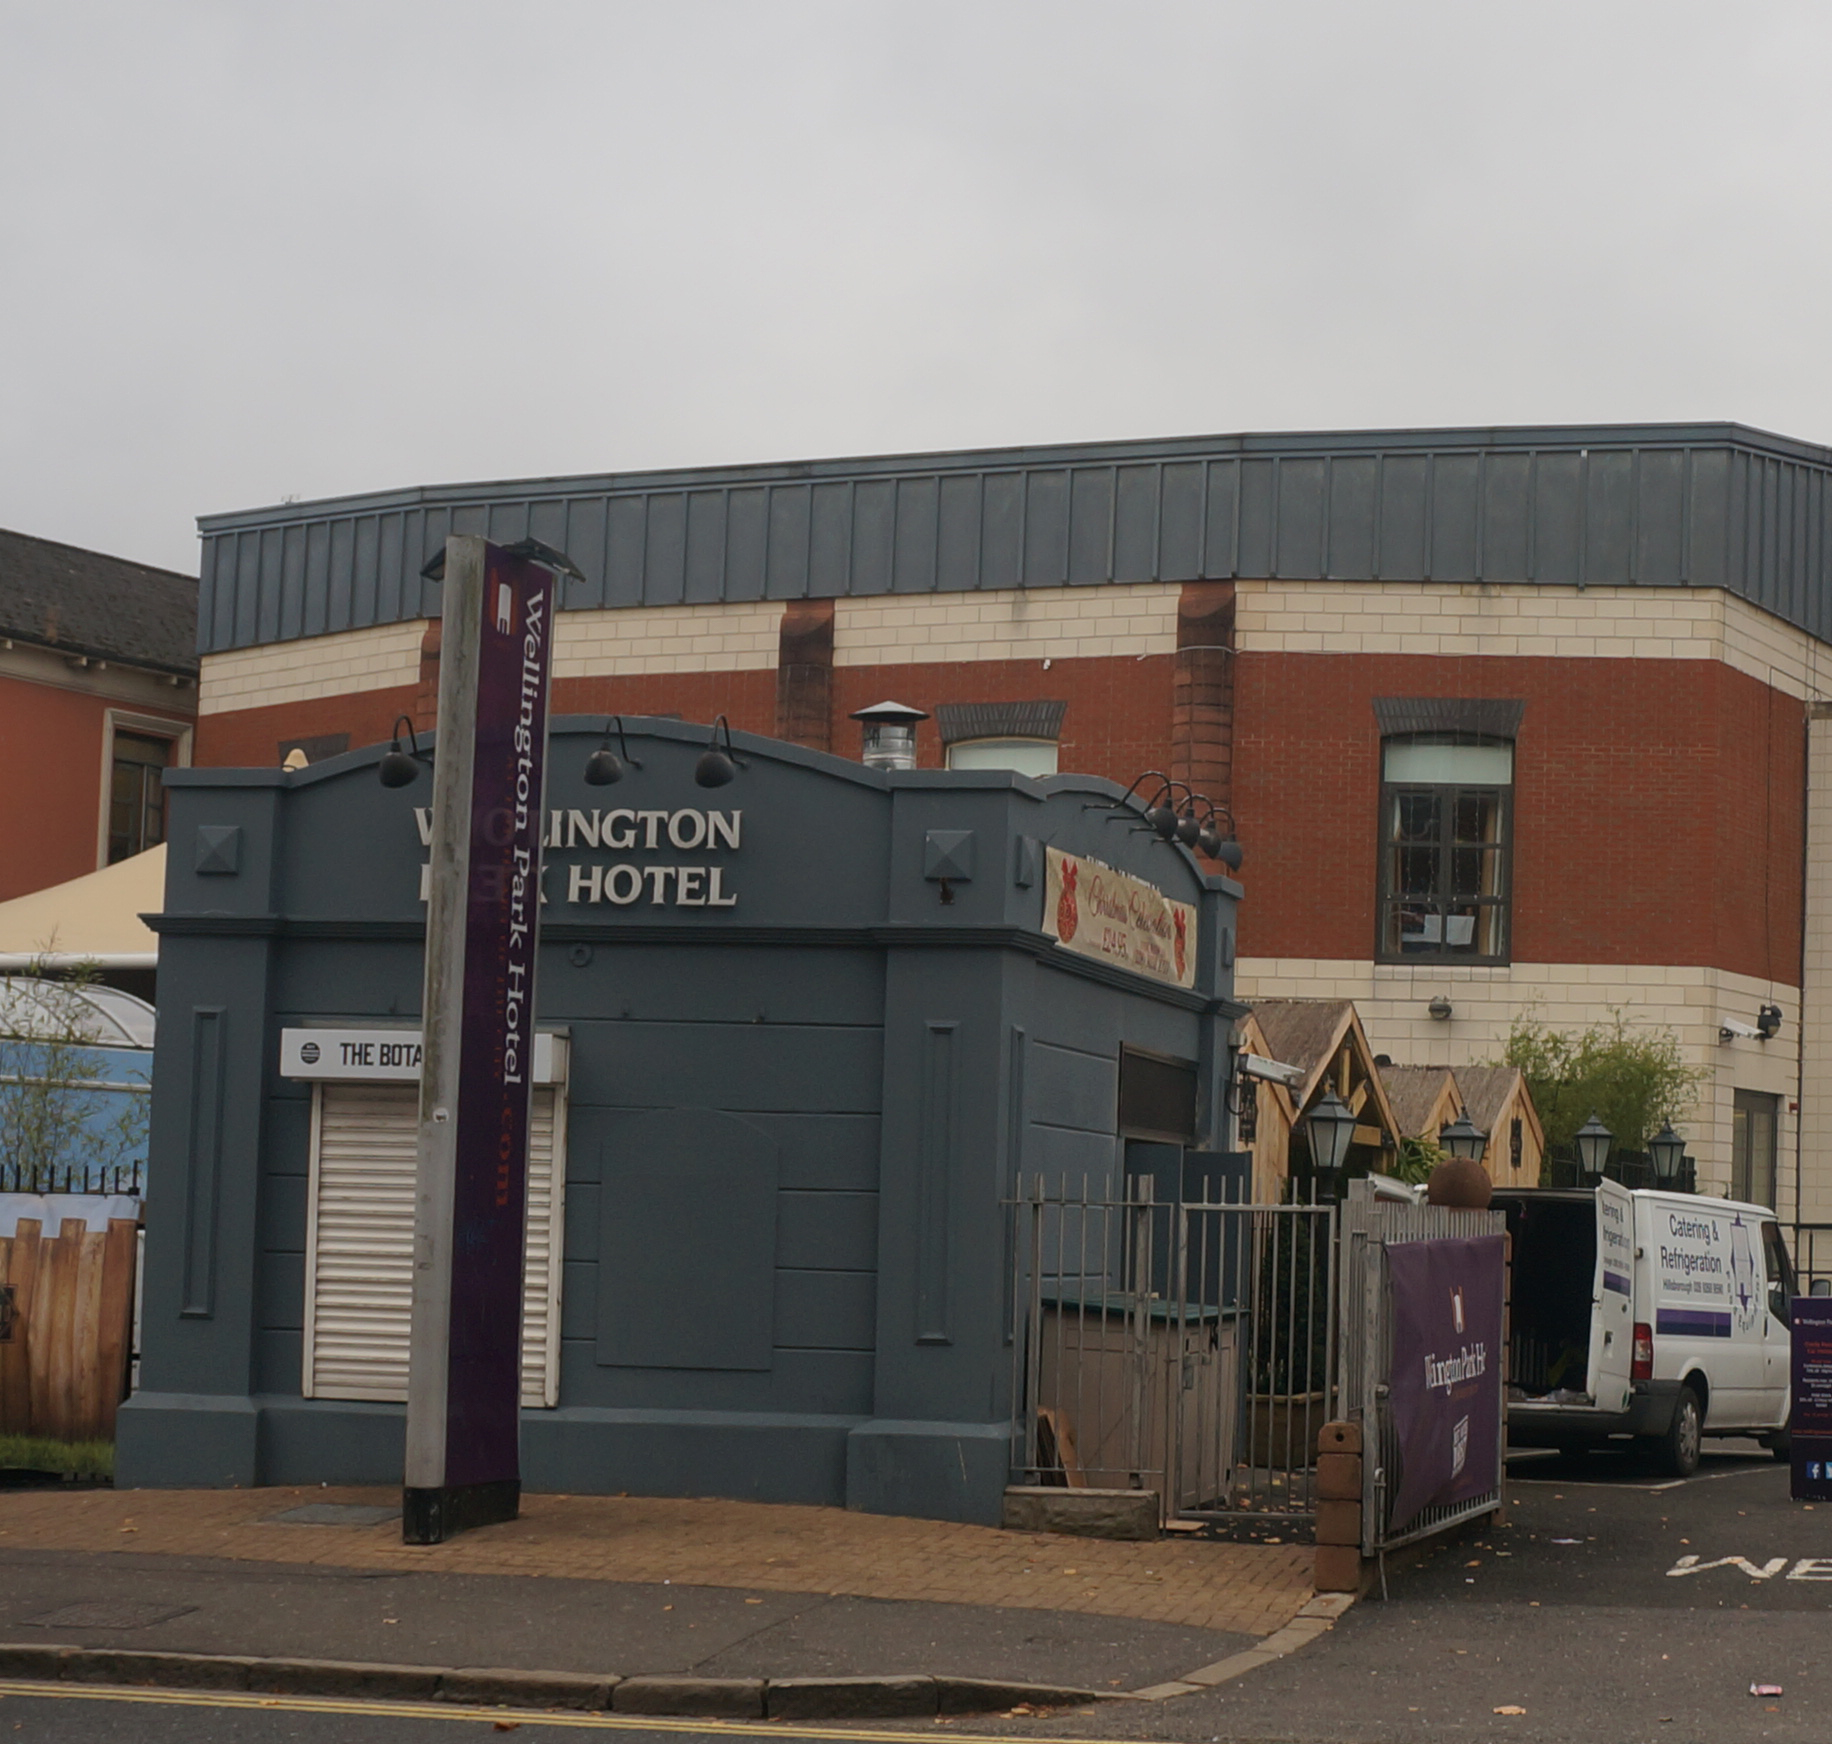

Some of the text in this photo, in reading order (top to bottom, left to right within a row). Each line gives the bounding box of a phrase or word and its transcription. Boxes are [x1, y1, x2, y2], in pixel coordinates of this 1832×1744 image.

[514, 588, 544, 833] Wellington
[509, 845, 531, 950] Park
[567, 864, 738, 906] HOTEL
[503, 963, 526, 1086] Hotel
[340, 1042, 375, 1065] THE
[1669, 1213, 1720, 1246] Catering &
[1660, 1245, 1722, 1276] Refrigeration
